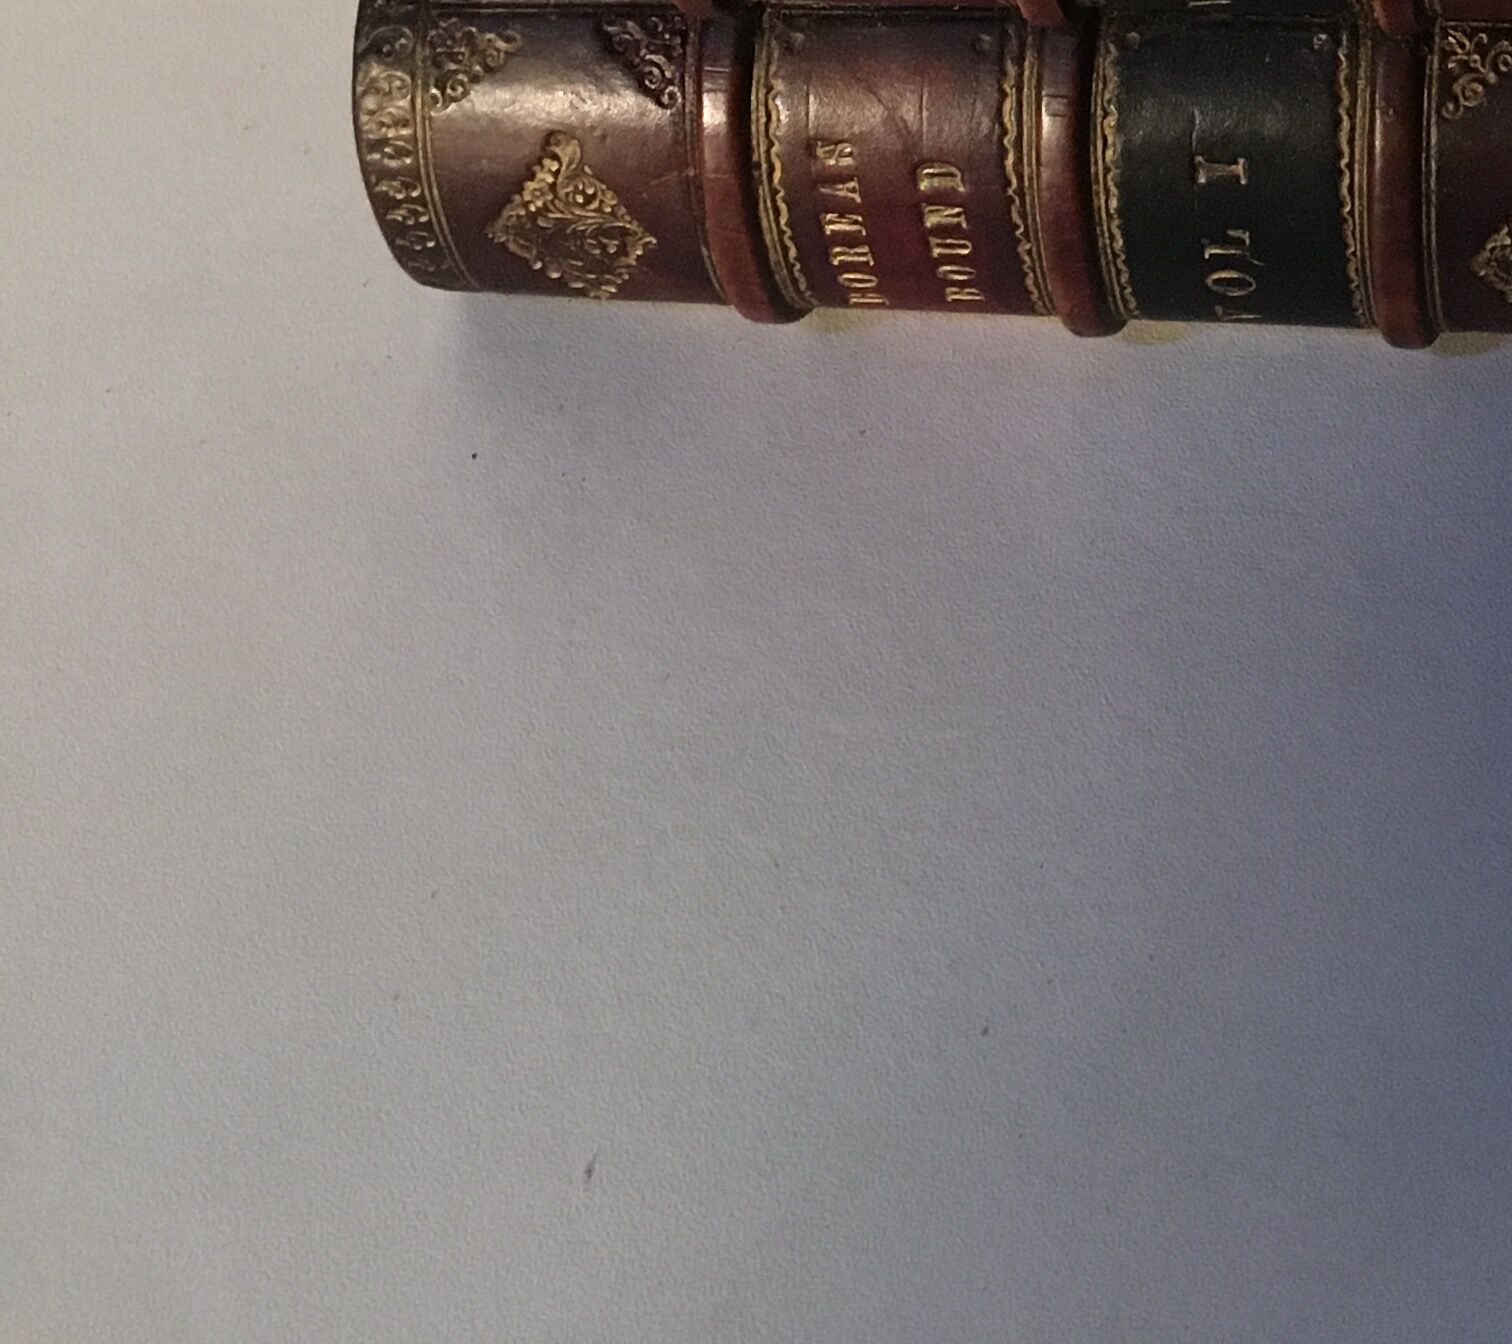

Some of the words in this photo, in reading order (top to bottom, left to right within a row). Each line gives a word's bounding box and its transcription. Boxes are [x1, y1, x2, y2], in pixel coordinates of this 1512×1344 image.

[815, 139, 889, 305] BOREAS
[917, 159, 984, 302] BOUND
[1194, 155, 1248, 185] I
